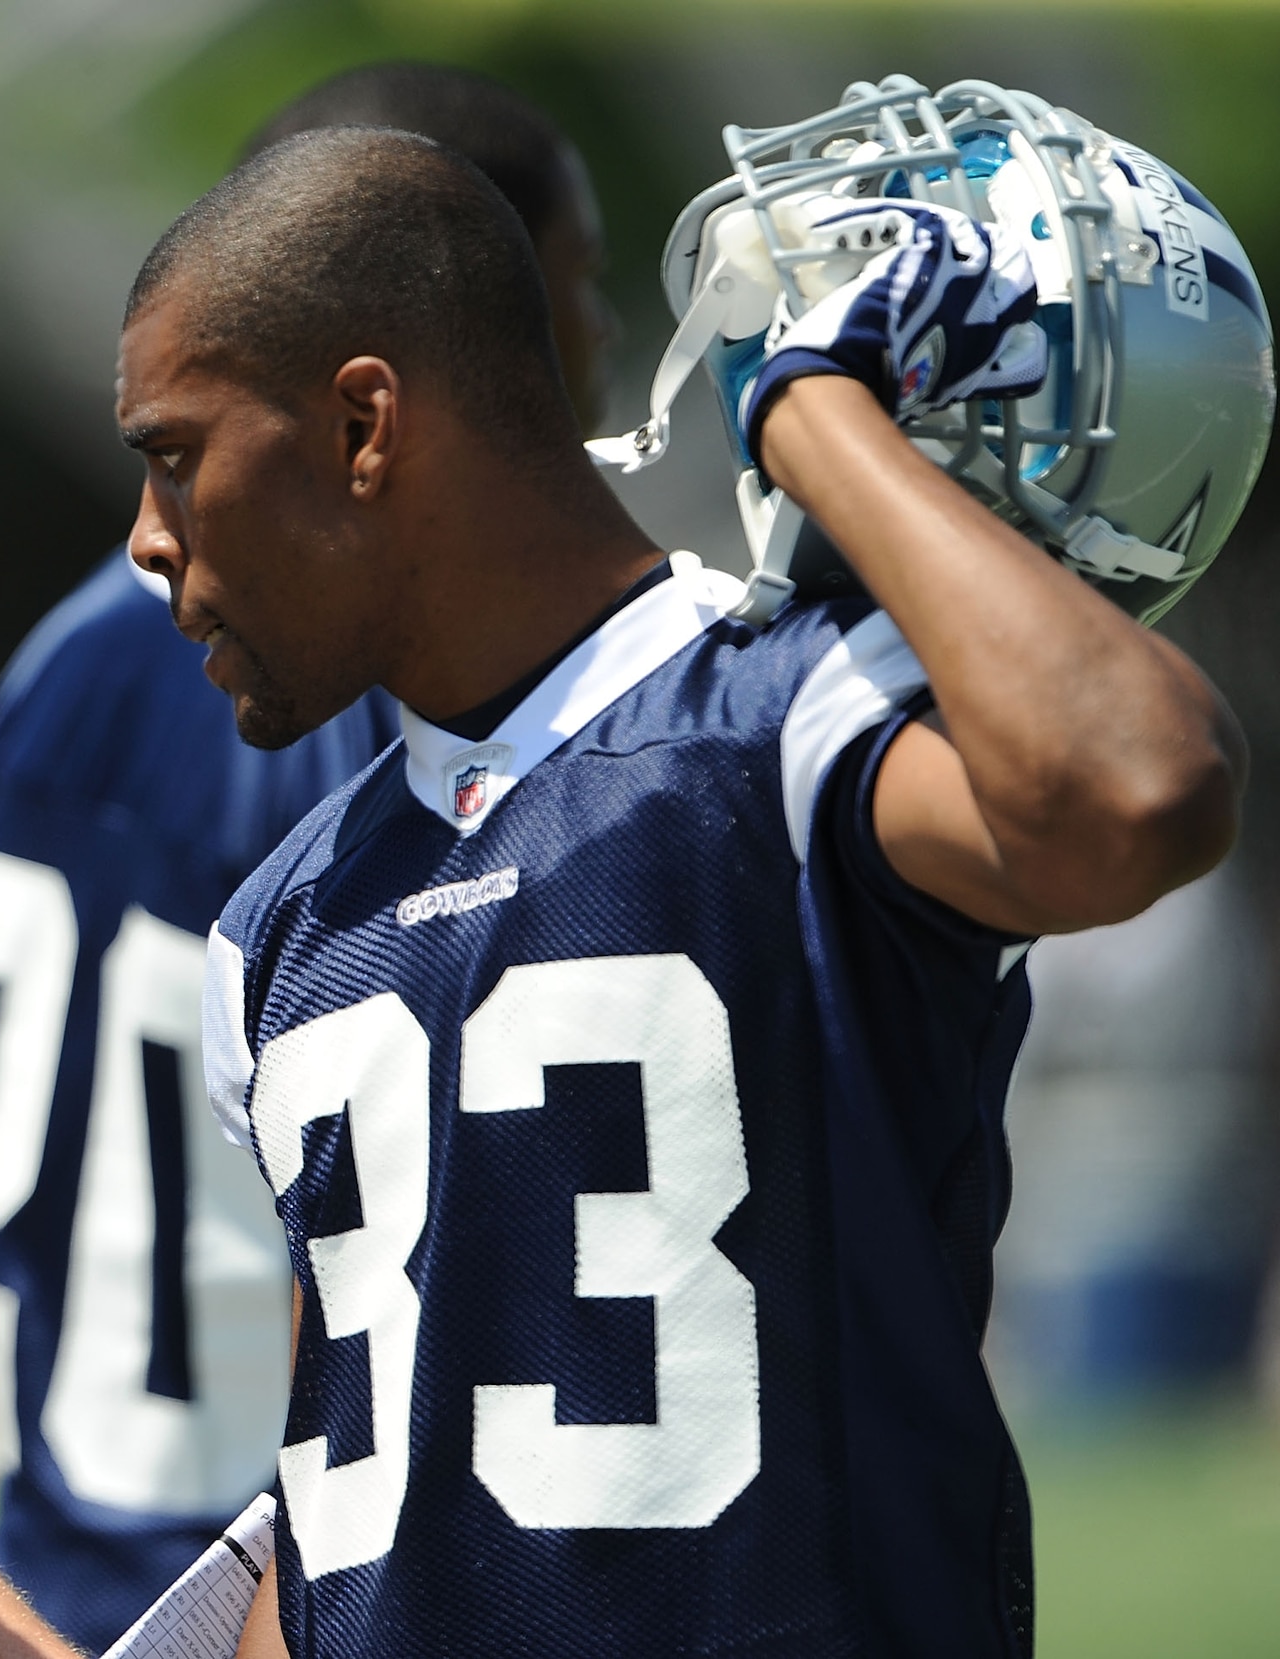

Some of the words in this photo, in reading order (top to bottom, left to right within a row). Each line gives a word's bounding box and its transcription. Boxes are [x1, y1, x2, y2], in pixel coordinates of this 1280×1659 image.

[250, 952, 762, 1582] 33
[260, 1512, 277, 1531] PR
[239, 1553, 258, 1575] PLAY
